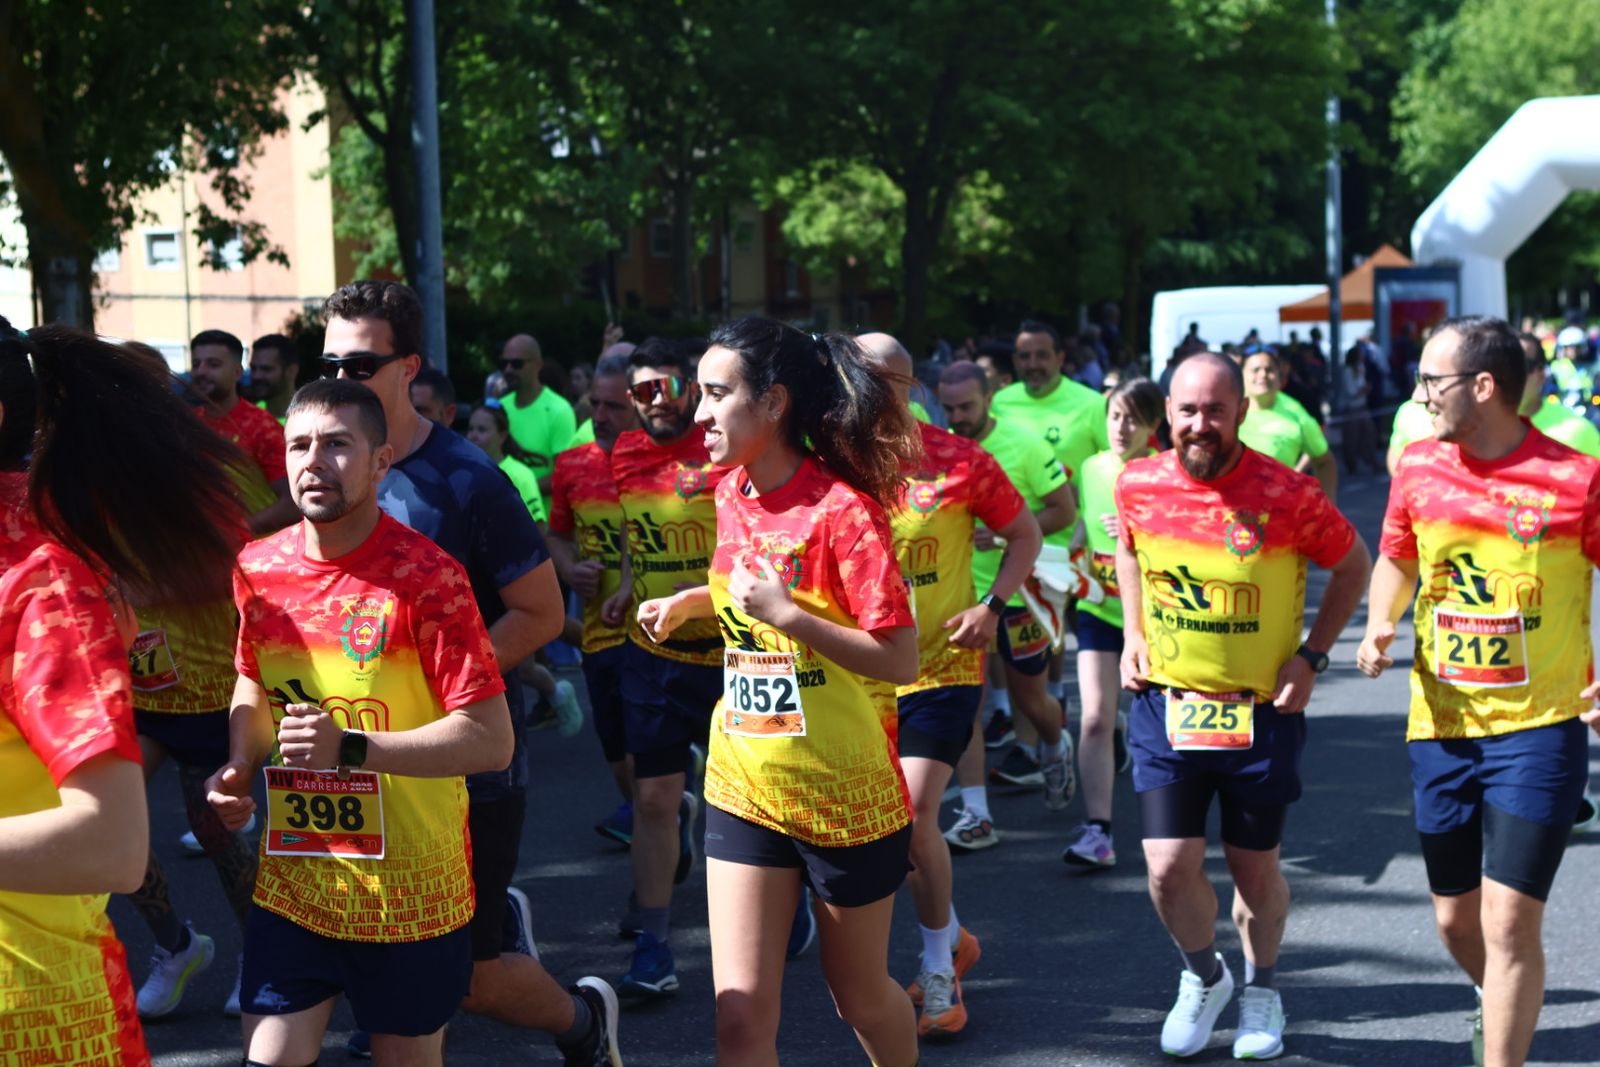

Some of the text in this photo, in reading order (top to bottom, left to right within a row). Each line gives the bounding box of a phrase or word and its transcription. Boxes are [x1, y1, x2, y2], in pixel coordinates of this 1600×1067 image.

[1177, 617, 1230, 633] FERNANDO
[1233, 620, 1260, 633] 2026
[1447, 633, 1510, 665] 212
[729, 674, 797, 713] 1852
[1180, 704, 1239, 731] 225
[269, 771, 293, 787] XIV
[296, 780, 348, 792] CARRERA
[284, 792, 365, 832] 398
[825, 817, 849, 831] VALOR
[851, 814, 867, 828] POR
[815, 832, 832, 845] POR
[386, 882, 422, 898] TRABAJO
[387, 898, 404, 911] POR
[393, 910, 419, 924] VALOR
[423, 903, 438, 920] POR
[353, 924, 379, 936] VALOR
[382, 924, 400, 937] POR
[416, 914, 450, 934] TRABAJO
[5, 984, 77, 1010] FORTALEZA
[37, 1029, 51, 1046] LA
[56, 1015, 107, 1043] VICTORIA
